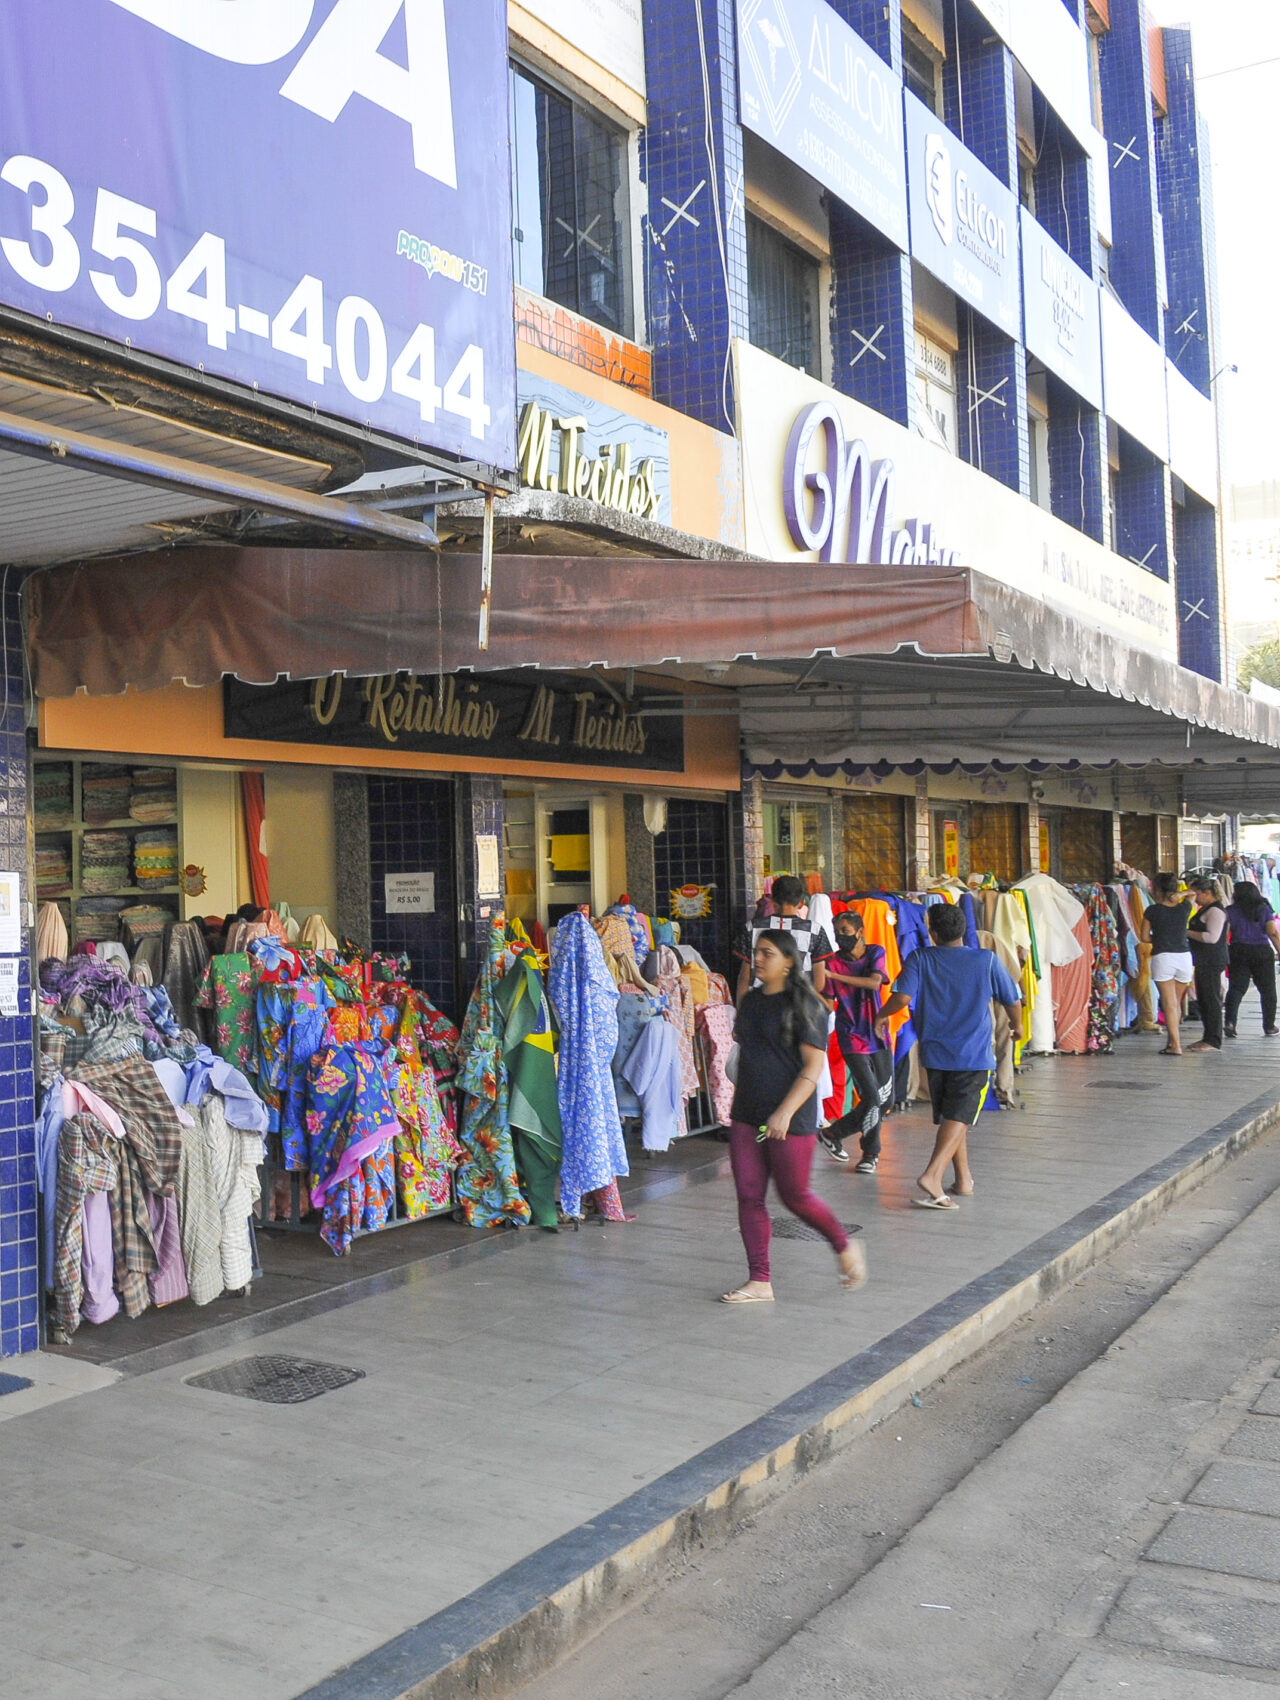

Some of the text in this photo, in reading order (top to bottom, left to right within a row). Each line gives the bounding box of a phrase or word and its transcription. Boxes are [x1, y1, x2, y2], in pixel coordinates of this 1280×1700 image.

[396, 230, 488, 296] PROCON 151
[364, 672, 499, 743] Retalhão
[519, 683, 560, 746] M.
[575, 693, 648, 754] Tecidos
